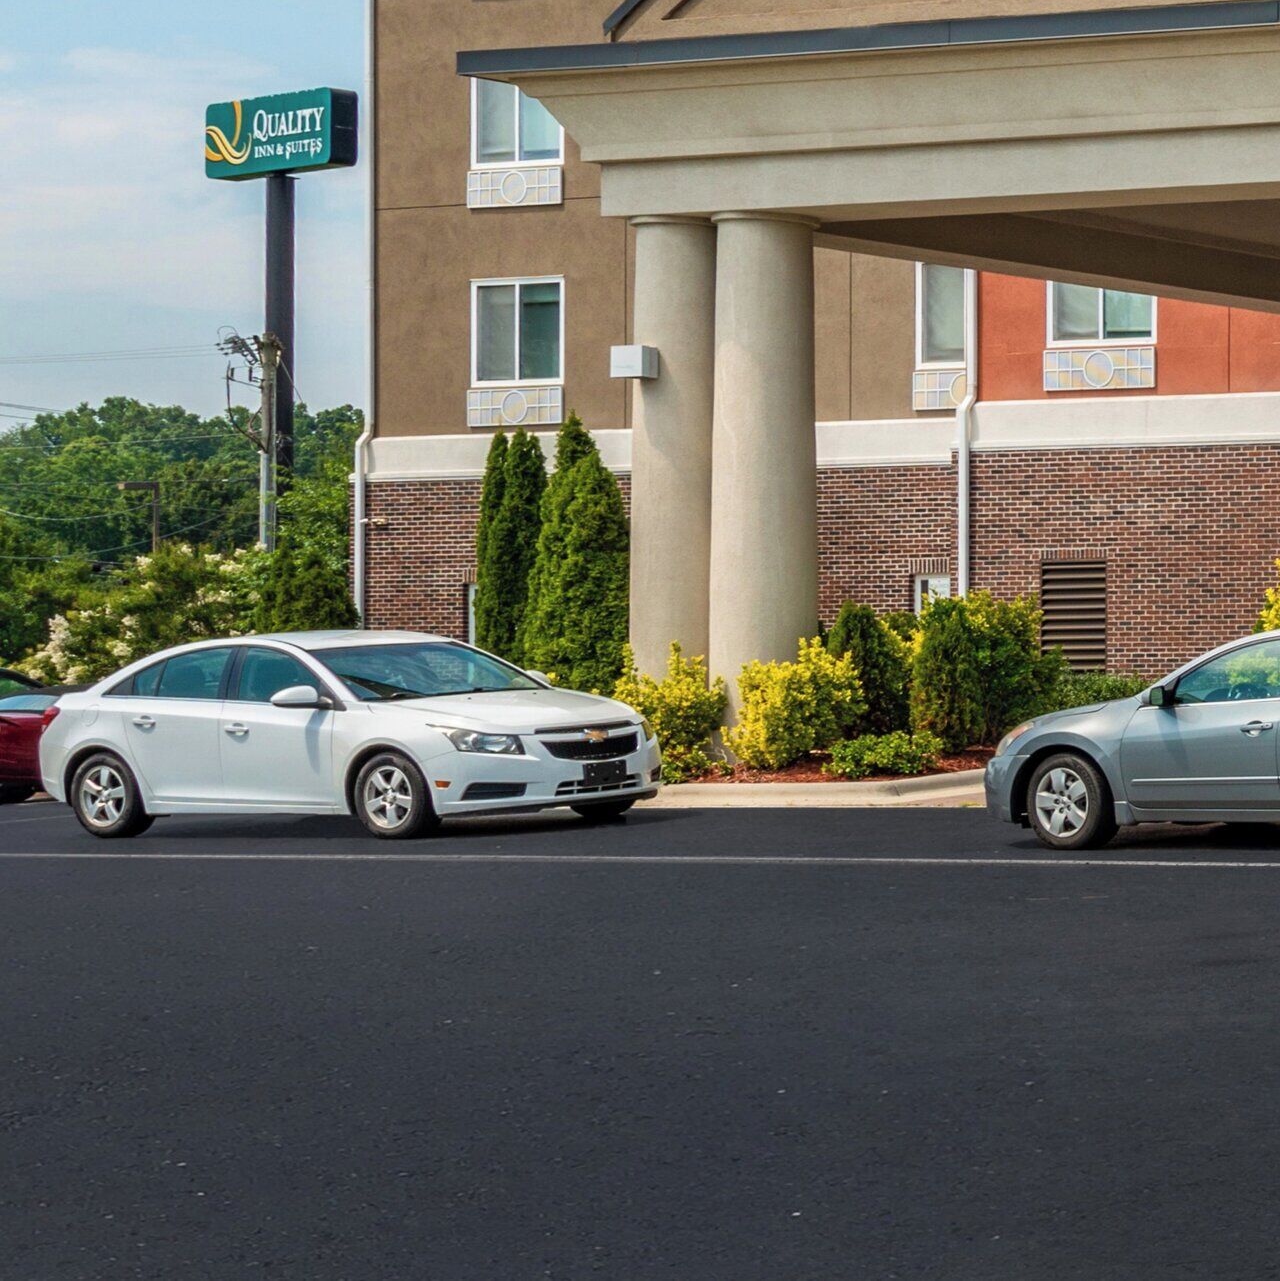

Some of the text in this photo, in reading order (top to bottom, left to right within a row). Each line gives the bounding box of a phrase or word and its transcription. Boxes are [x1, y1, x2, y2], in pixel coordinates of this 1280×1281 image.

[253, 107, 324, 142] QUALITY
[254, 138, 322, 158] INN & SUITES
